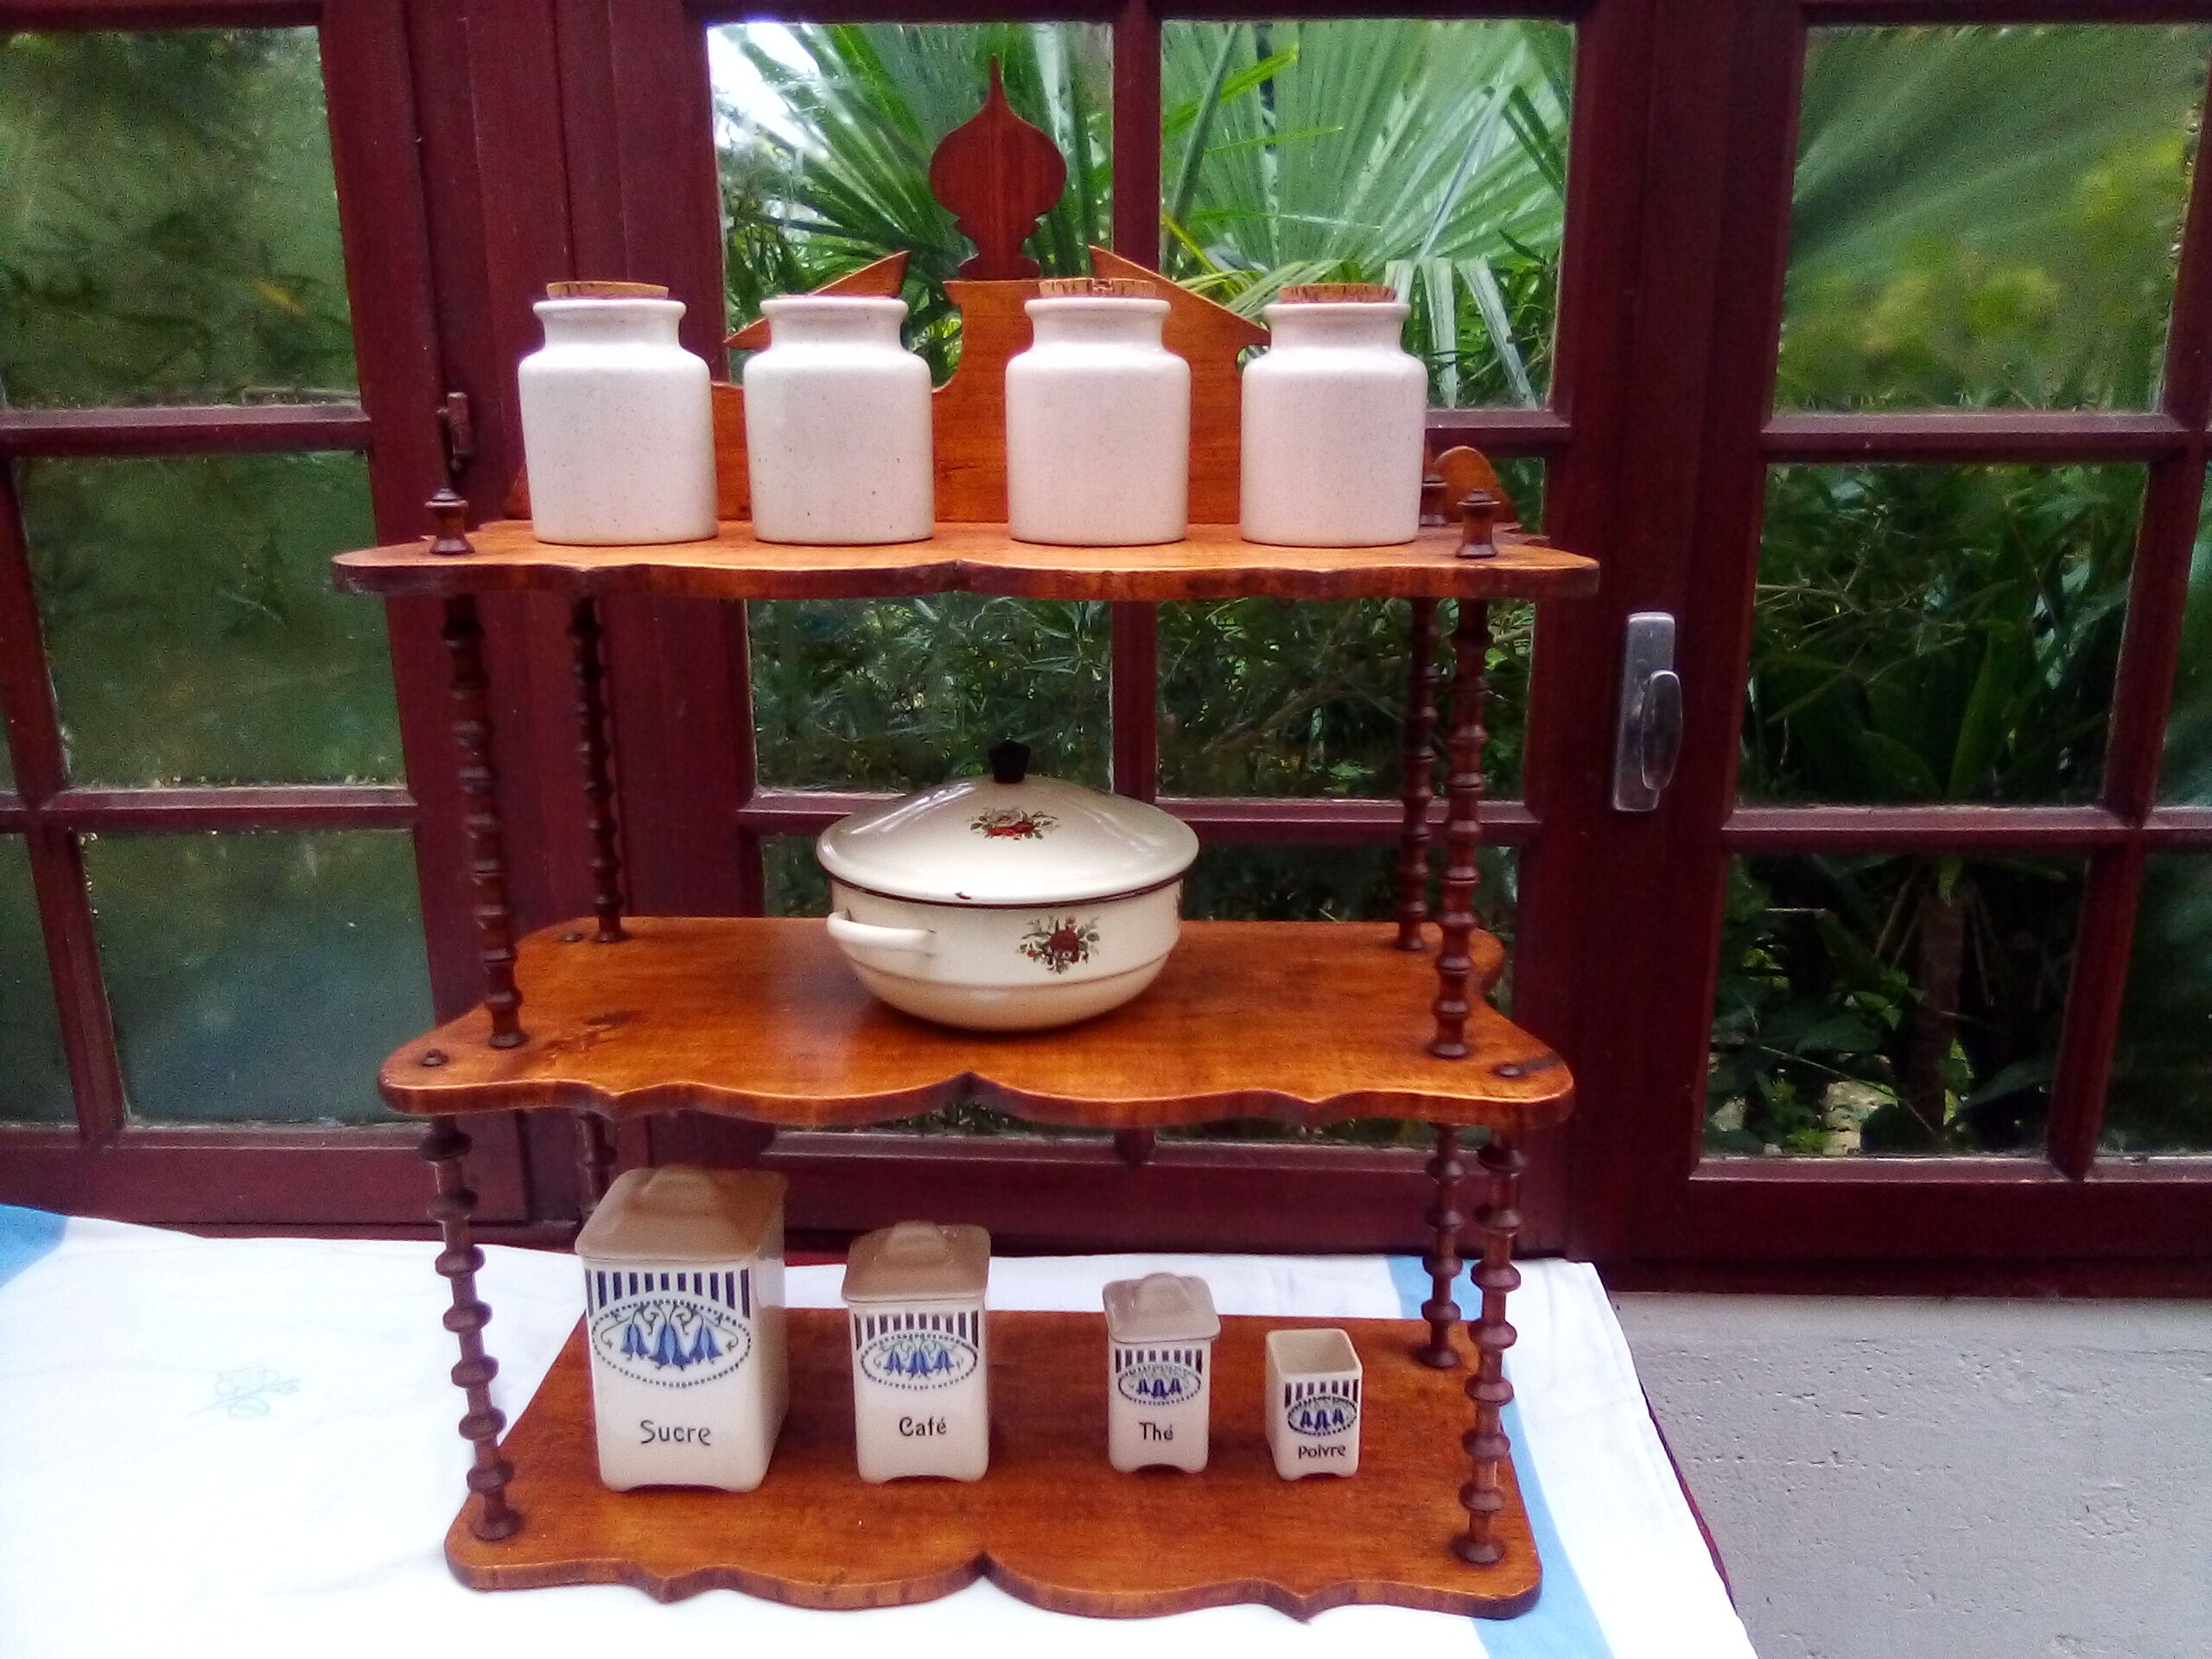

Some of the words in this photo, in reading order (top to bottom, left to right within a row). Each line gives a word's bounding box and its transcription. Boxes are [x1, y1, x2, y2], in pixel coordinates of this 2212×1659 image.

[640, 1420, 711, 1446] Sucre
[899, 1416, 947, 1437] Café
[1138, 1421, 1174, 1442] Thé
[1298, 1443, 1347, 1460] Poivre
